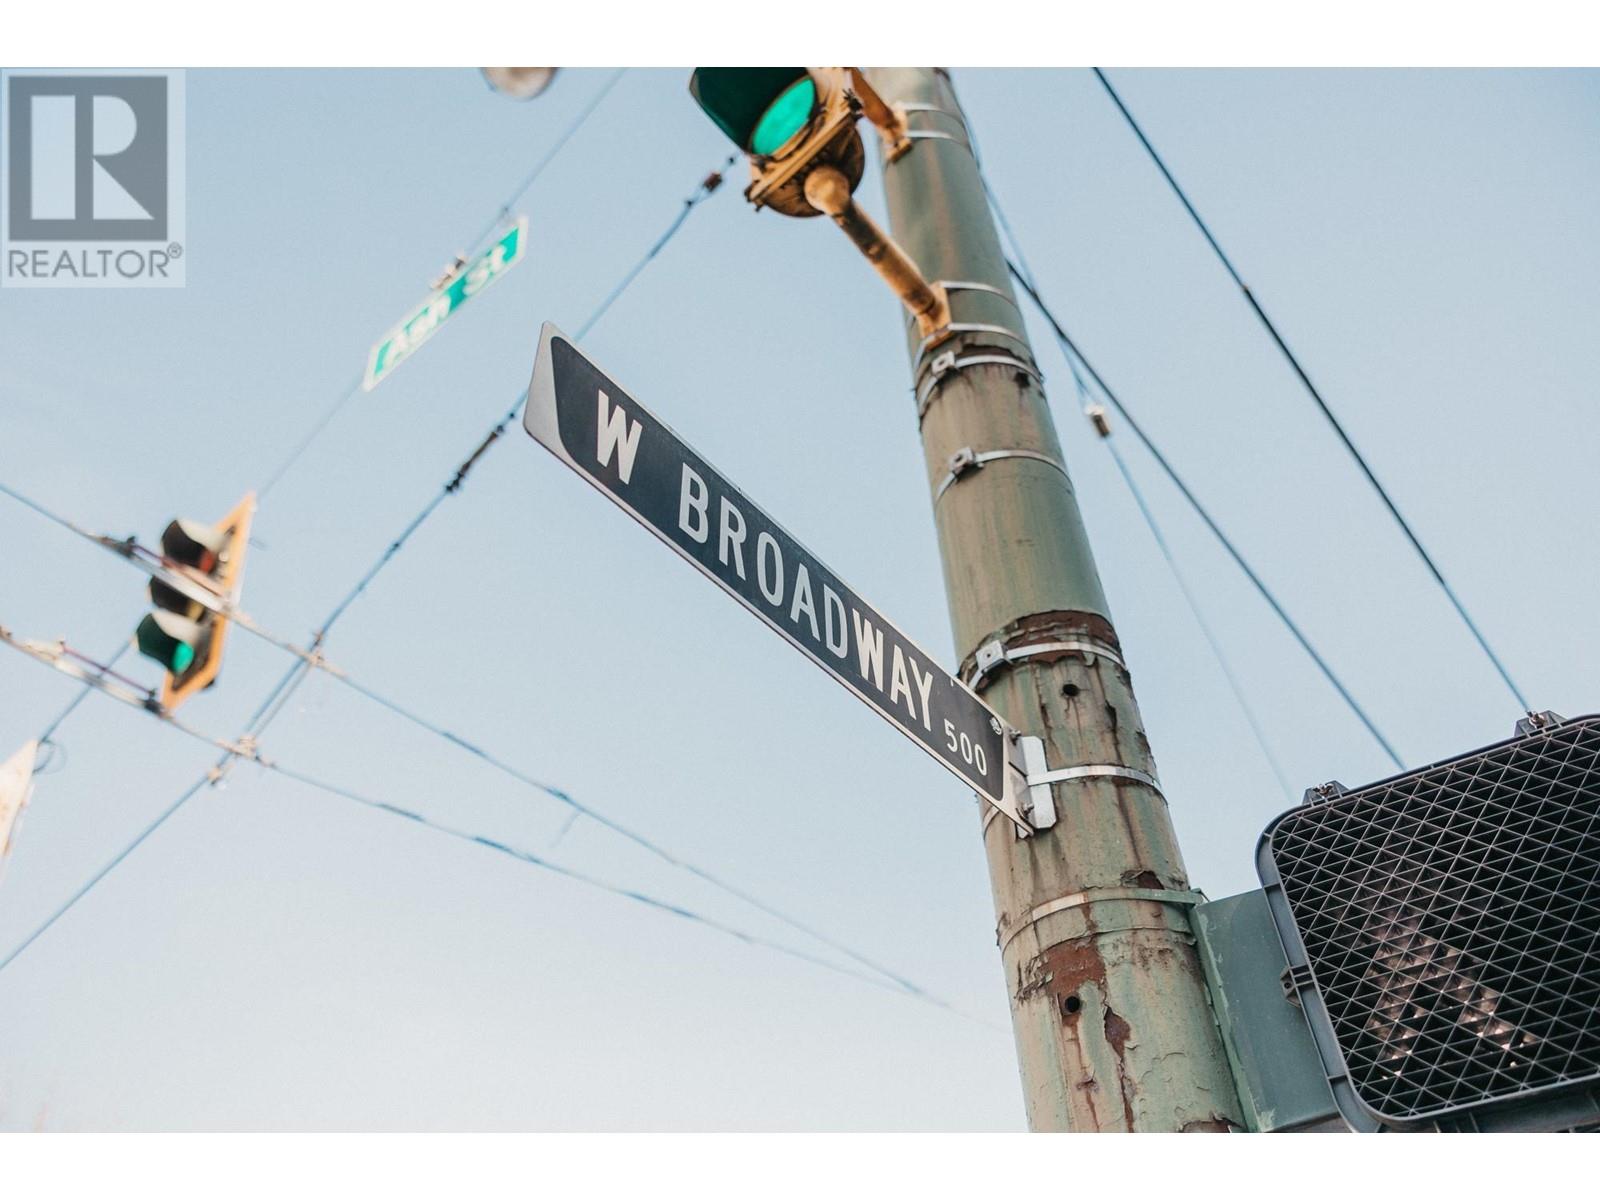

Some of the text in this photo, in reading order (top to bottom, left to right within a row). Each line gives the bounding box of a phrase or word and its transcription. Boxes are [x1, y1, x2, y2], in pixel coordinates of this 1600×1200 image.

[462, 243, 507, 297] St
[597, 388, 934, 732] W BROADWAY
[943, 718, 988, 777] 500
